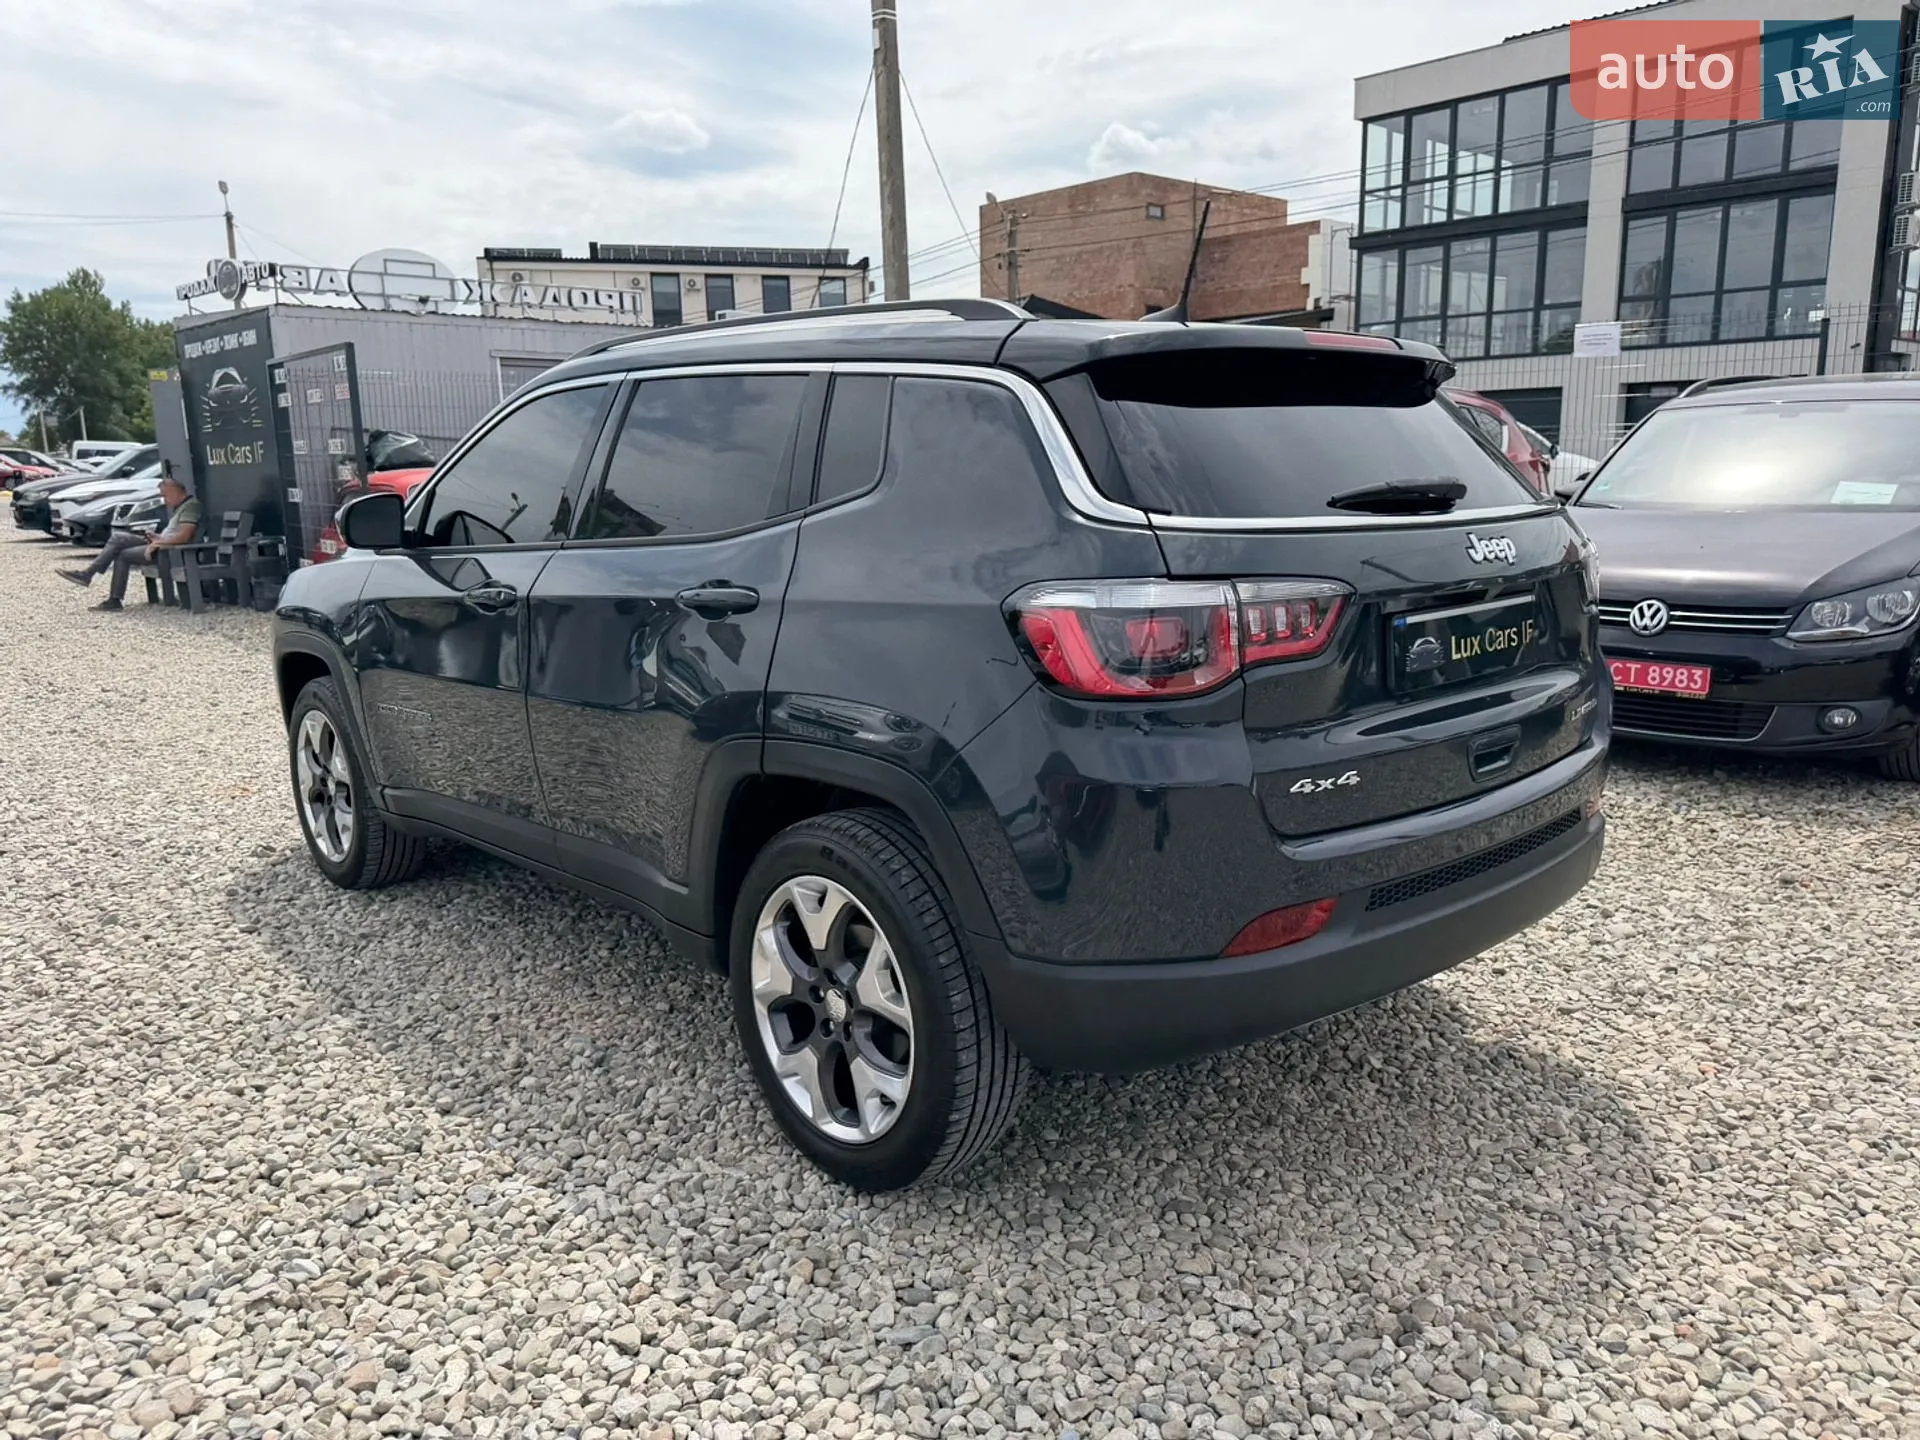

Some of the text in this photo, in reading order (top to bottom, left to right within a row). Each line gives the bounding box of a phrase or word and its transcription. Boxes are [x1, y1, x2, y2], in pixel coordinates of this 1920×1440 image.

[240, 261, 270, 284] АВТО
[206, 440, 264, 465] Lux Cars IF
[1466, 532, 1516, 564] Jeep
[1451, 619, 1534, 660] Lux Cars IF
[1610, 662, 1703, 689] CT 8983
[1290, 771, 1360, 793] 4x4
